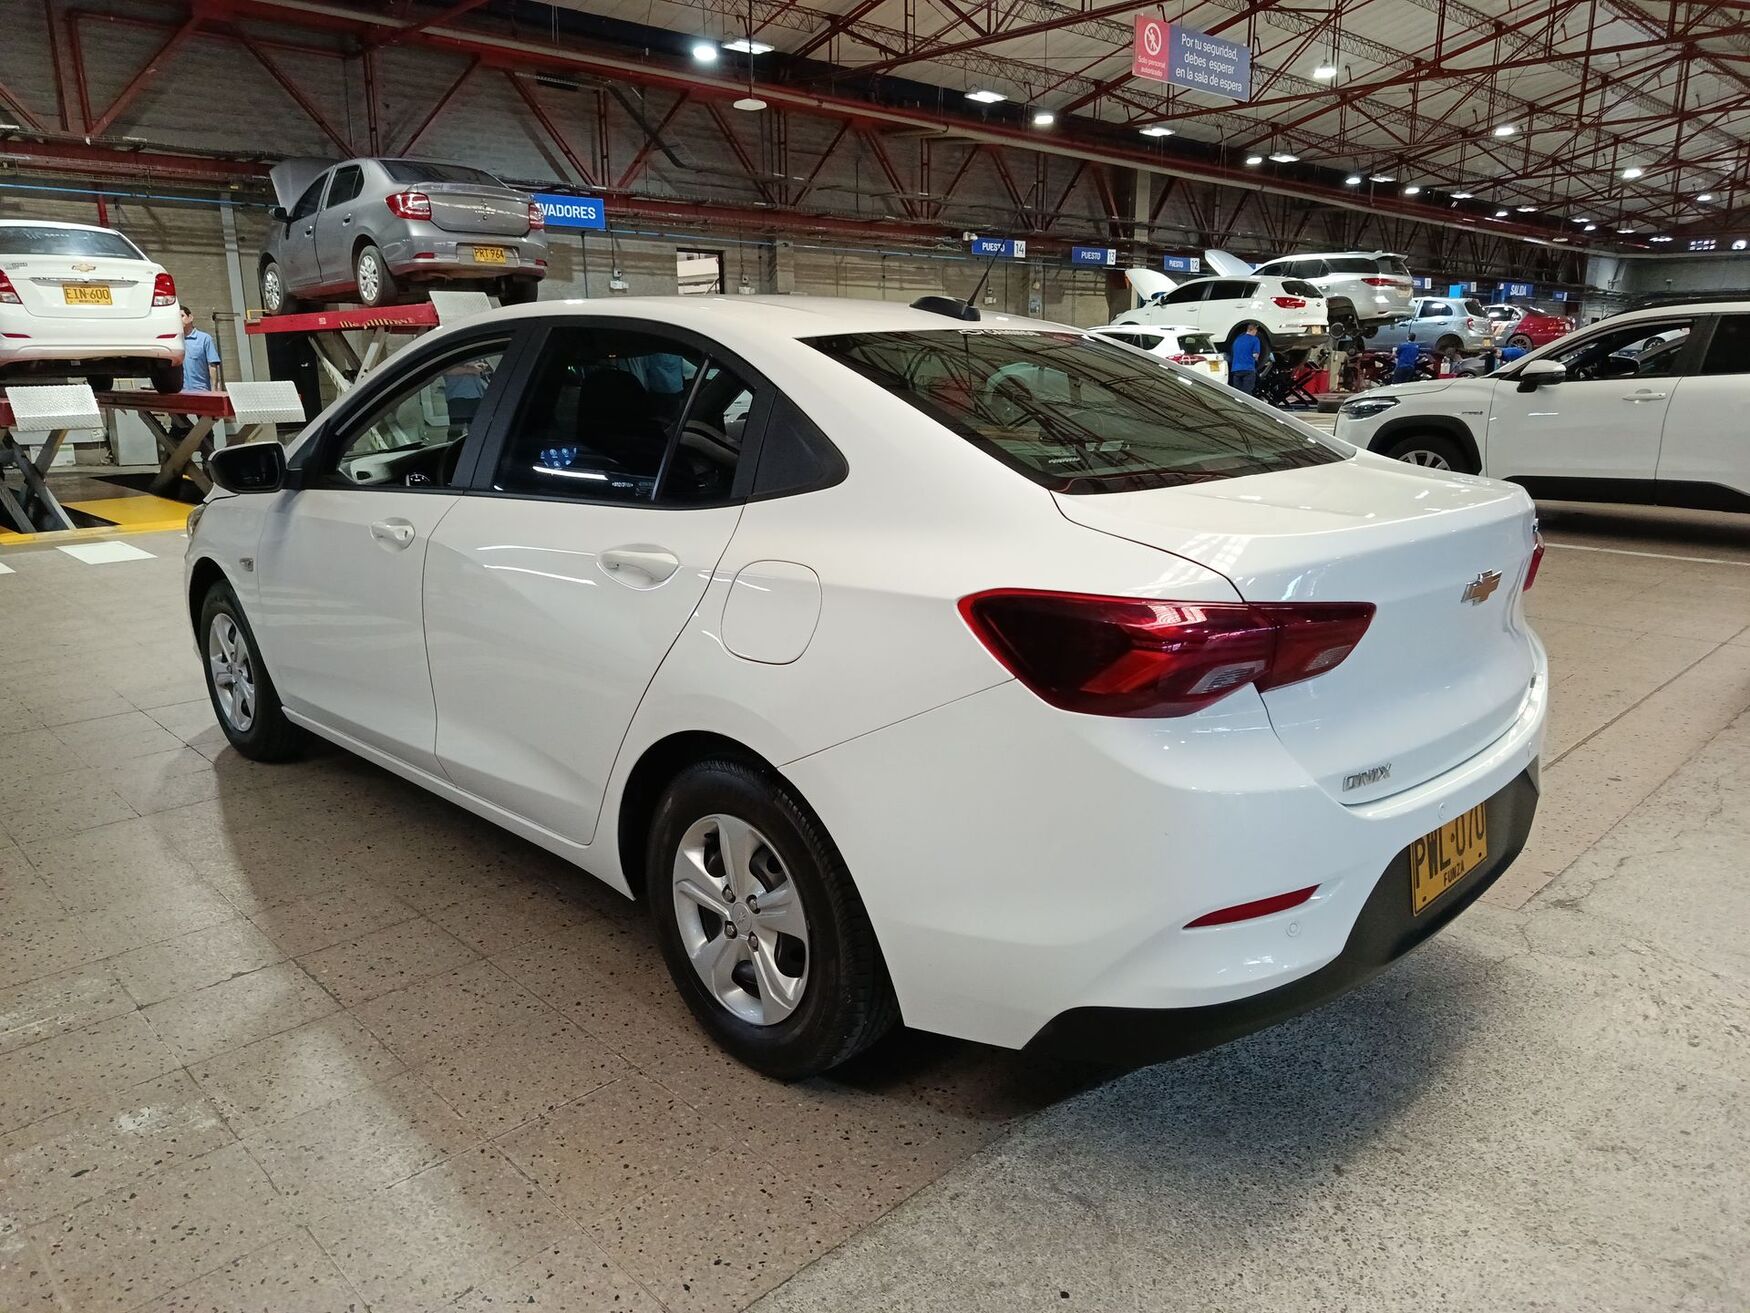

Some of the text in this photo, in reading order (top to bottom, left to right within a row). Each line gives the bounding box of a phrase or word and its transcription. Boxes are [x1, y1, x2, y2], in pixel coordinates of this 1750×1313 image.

[1181, 33, 1239, 62] Por tu seguridad,
[1184, 51, 1235, 74] debes esperar
[1175, 66, 1243, 92] en la sala de espera
[541, 203, 597, 220] VADORES
[981, 242, 1025, 255] PUESTO 14
[1081, 251, 1101, 260] PUESTO
[1510, 284, 1528, 296] SALIDA
[1443, 860, 1465, 887] FUNZA
